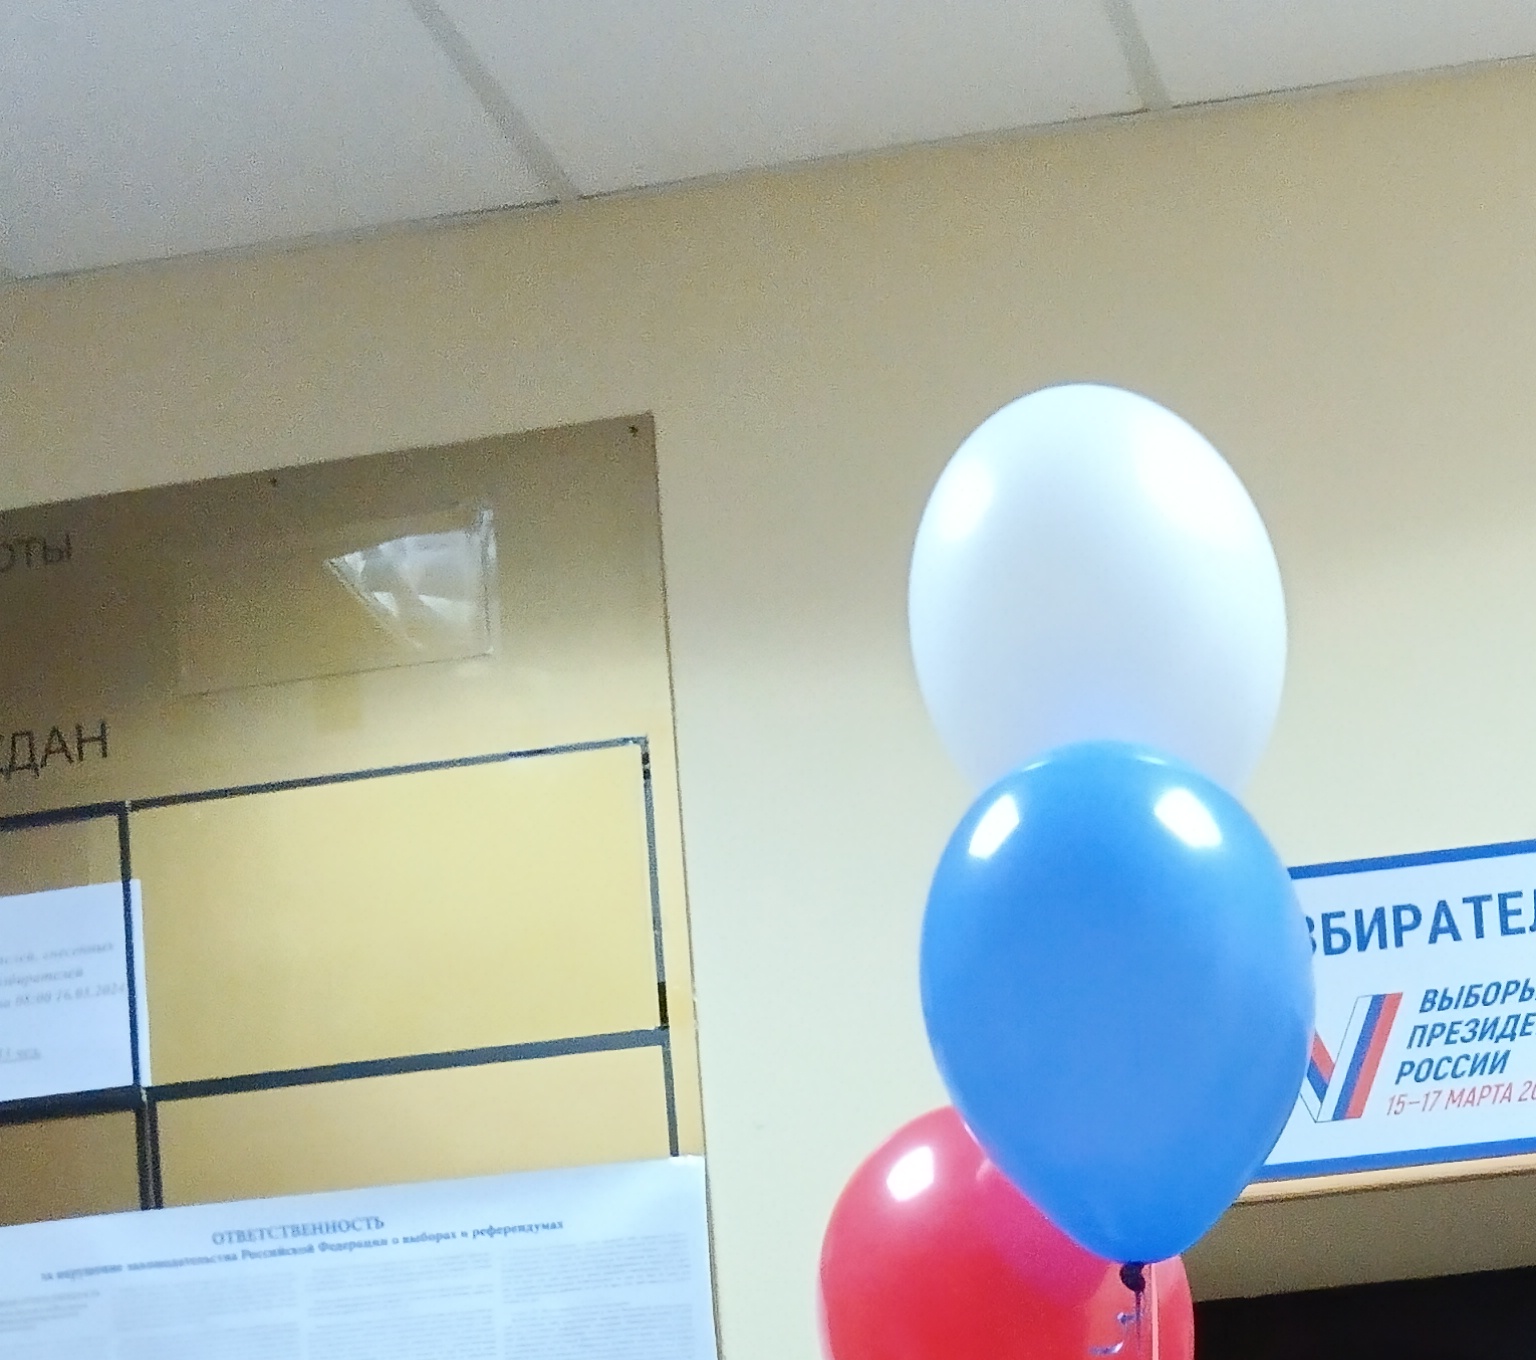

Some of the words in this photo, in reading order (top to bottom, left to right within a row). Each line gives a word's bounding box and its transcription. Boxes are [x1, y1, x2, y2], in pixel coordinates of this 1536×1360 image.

[0, 718, 108, 780] ДАН
[1394, 1049, 1512, 1085] РОССИИ
[1443, 1081, 1513, 1111] МАРТА
[212, 1215, 385, 1246] ОТВЕТСТВЕННОСТЬ
[472, 1219, 564, 1240] референдумах
